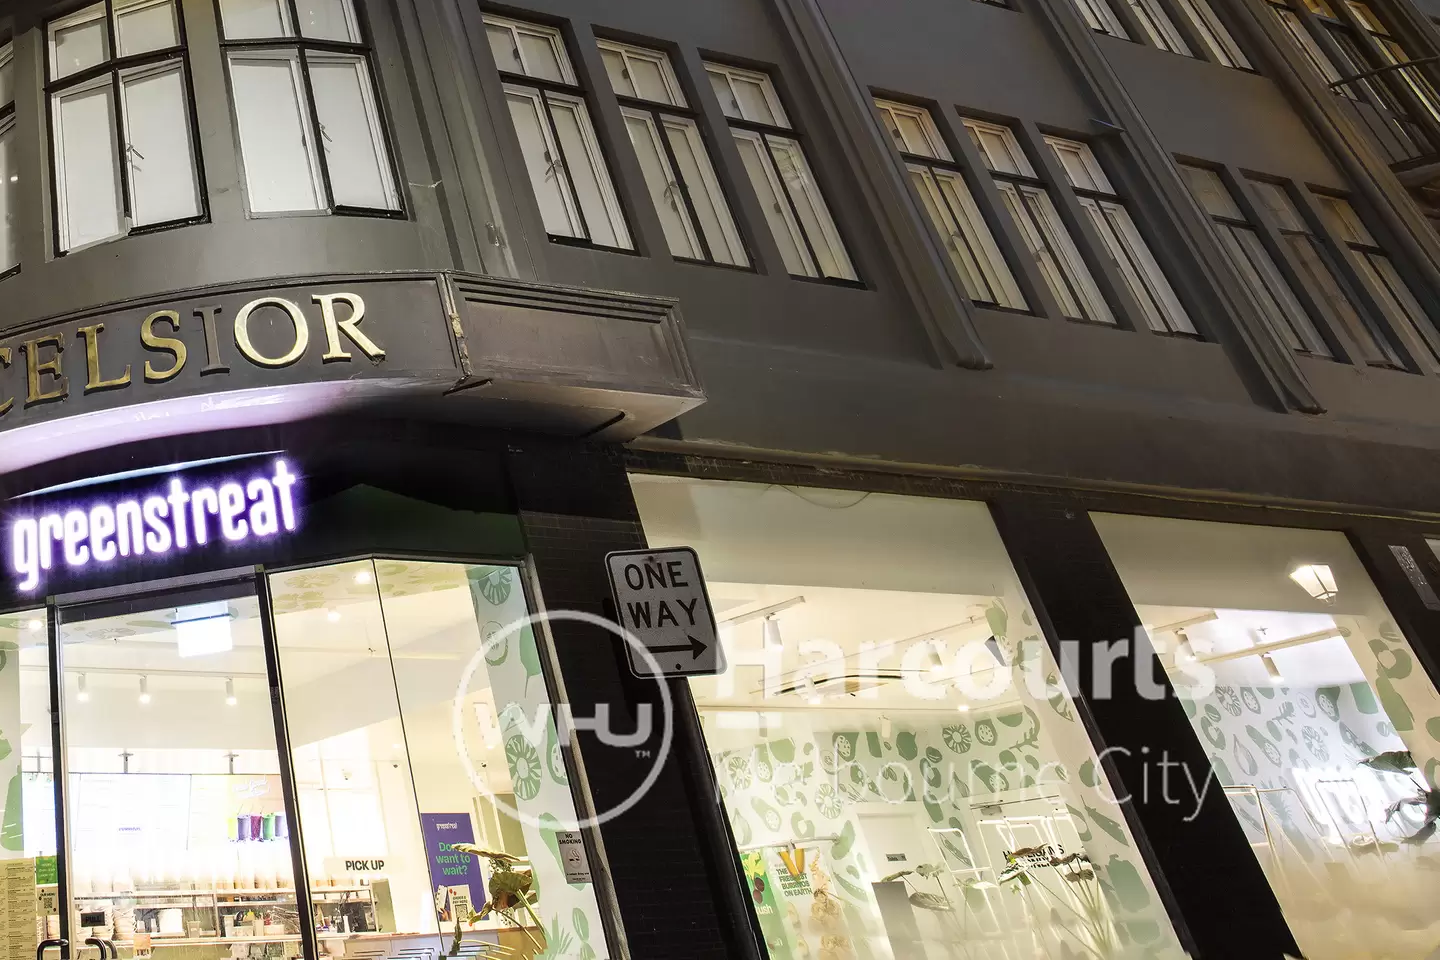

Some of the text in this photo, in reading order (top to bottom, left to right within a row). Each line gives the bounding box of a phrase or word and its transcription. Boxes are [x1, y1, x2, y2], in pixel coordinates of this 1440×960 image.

[12, 459, 296, 591] greenstreat
[624, 561, 689, 590] ONE
[627, 598, 698, 629] WAY
[435, 854, 471, 864] want to
[345, 860, 385, 871] PICK UP
[442, 865, 468, 876] wait?
[776, 867, 789, 876] THE
